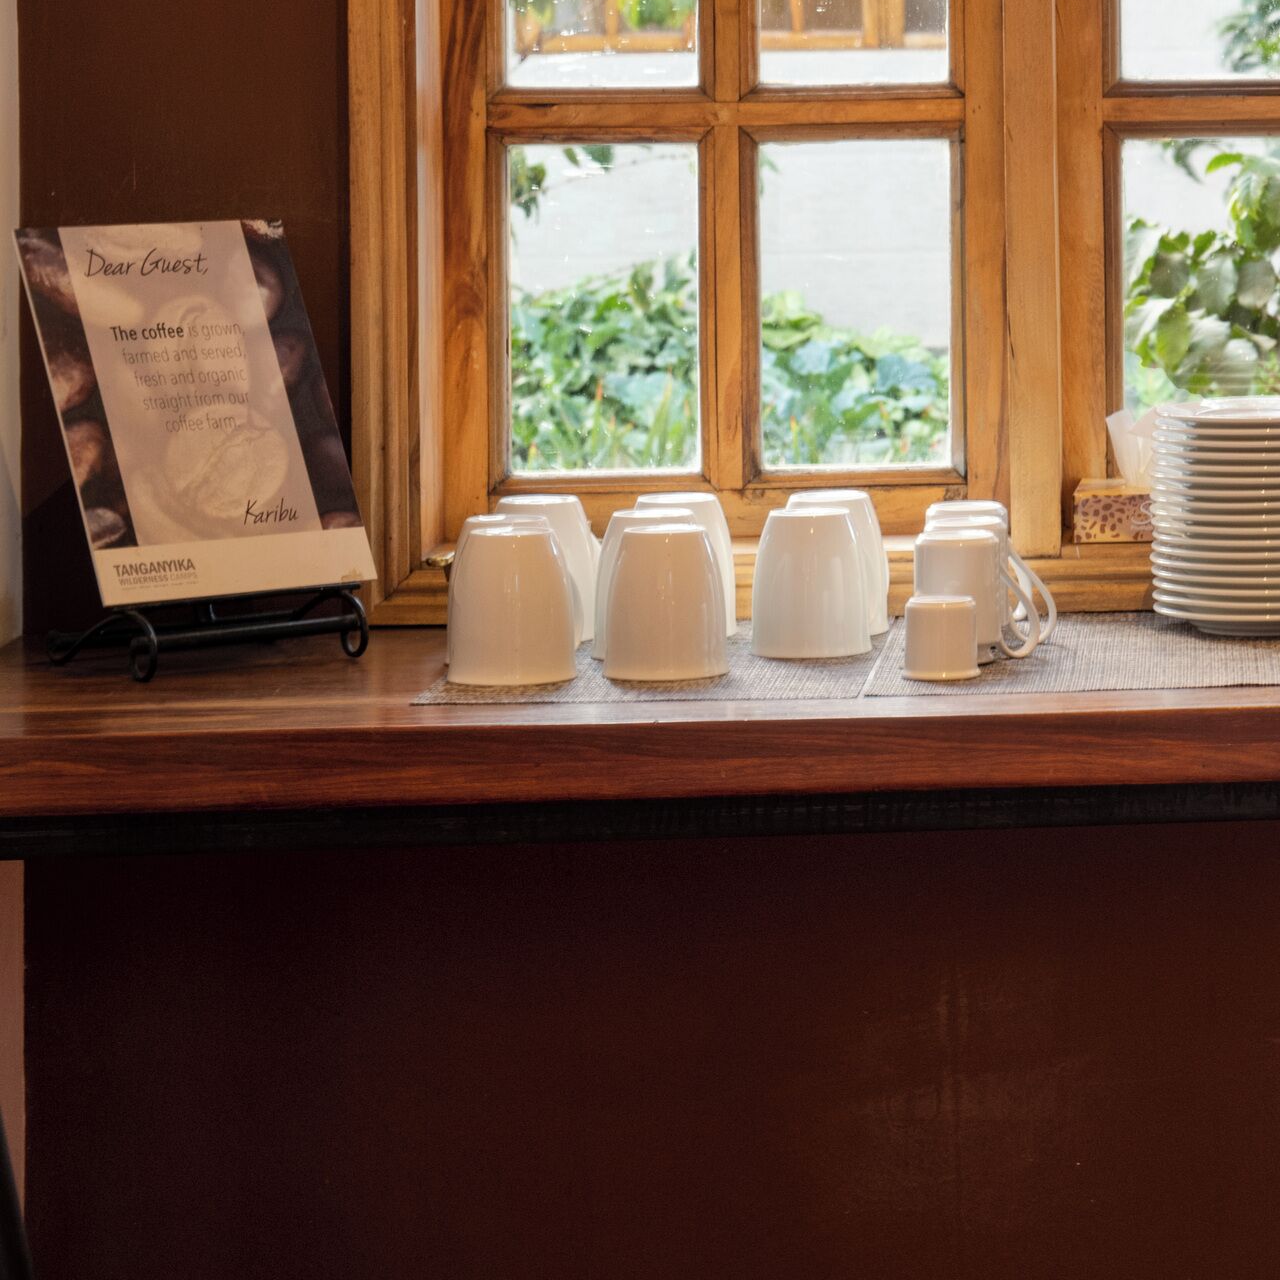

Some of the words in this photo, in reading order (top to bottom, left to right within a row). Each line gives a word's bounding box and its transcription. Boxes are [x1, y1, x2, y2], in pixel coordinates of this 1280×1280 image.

[84, 248, 134, 277] Dear
[141, 248, 208, 276] Guest,
[110, 325, 137, 341] The
[141, 323, 184, 339] coffee
[187, 325, 199, 337] is
[201, 322, 245, 340] grown,
[122, 346, 169, 364] farmed
[173, 345, 198, 361] and
[201, 342, 246, 360] served,
[134, 369, 167, 387] fresh
[170, 368, 195, 385] and
[198, 366, 247, 386] organic
[143, 392, 192, 413] straight
[193, 389, 225, 406] from
[227, 391, 249, 404] our
[165, 415, 204, 432] coffee
[243, 498, 299, 526] Karibu
[113, 558, 196, 577] TANGANYIKA
[119, 574, 169, 586] WILDERNESS
